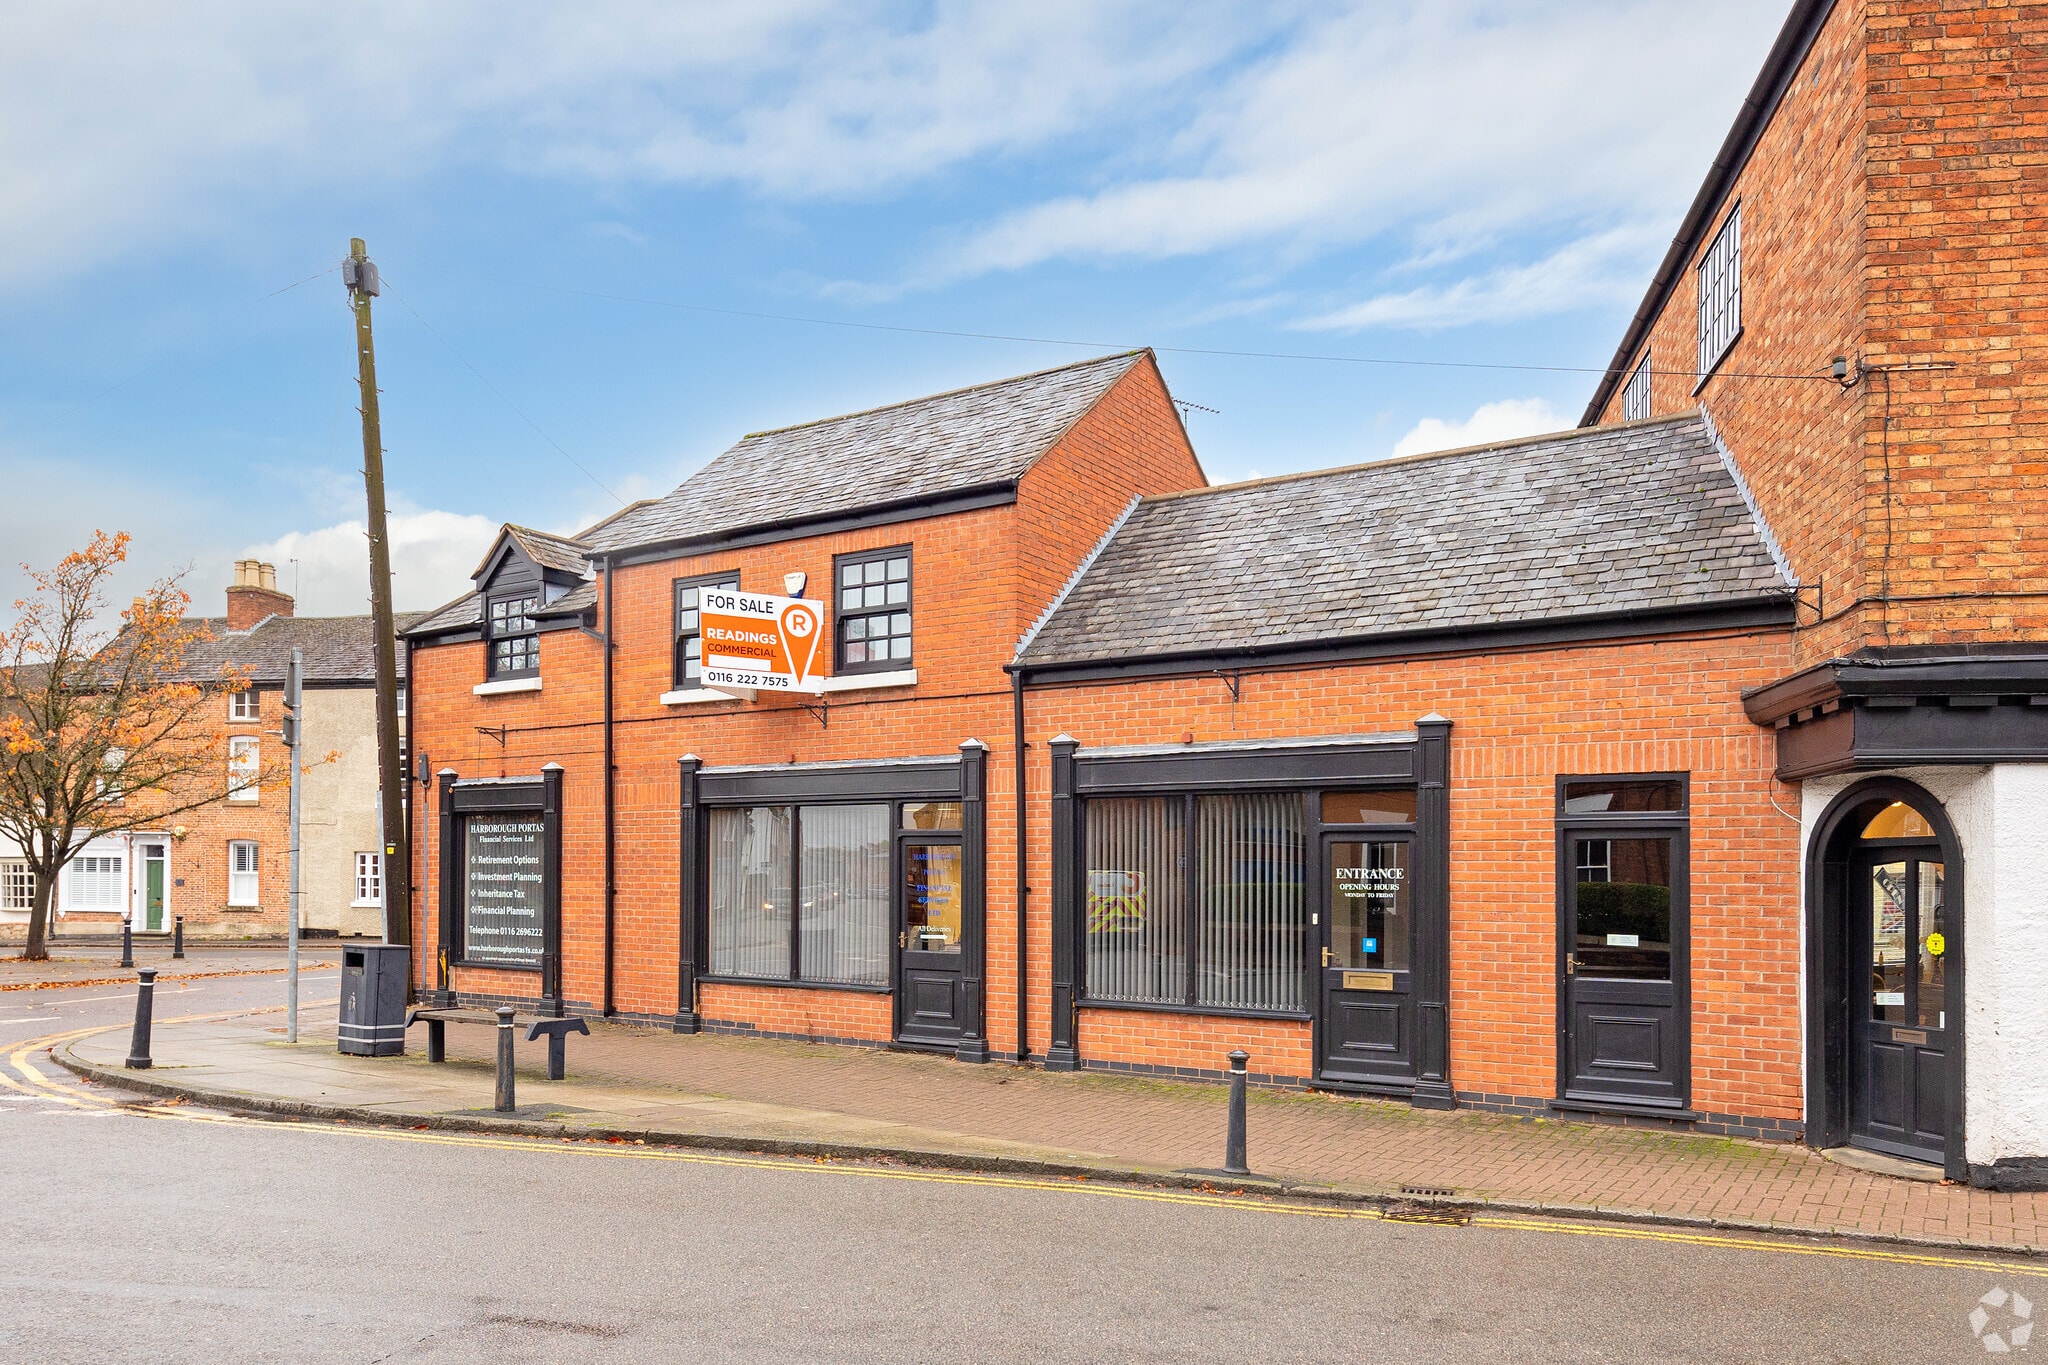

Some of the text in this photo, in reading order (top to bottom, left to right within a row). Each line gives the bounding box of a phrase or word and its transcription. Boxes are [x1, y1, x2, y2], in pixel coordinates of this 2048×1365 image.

[707, 594, 774, 614] FOR SALE
[792, 614, 806, 631] R
[706, 627, 777, 645] READINGS
[707, 642, 777, 658] COMMERCIAL
[708, 671, 788, 687] 0116 222 7575
[470, 823, 545, 833] HARBOROUGH PORTAS
[479, 834, 534, 843] Financial Services Ltd
[478, 855, 539, 866] Retirement Options
[478, 871, 542, 883] Investment Planning
[1336, 868, 1404, 879] ENTRANCE
[1339, 883, 1400, 891] OPENING HOURS
[478, 889, 525, 898] Inheritance Tax
[478, 905, 535, 918] Financial Planning
[469, 925, 543, 937] Telephone 0116 2696222
